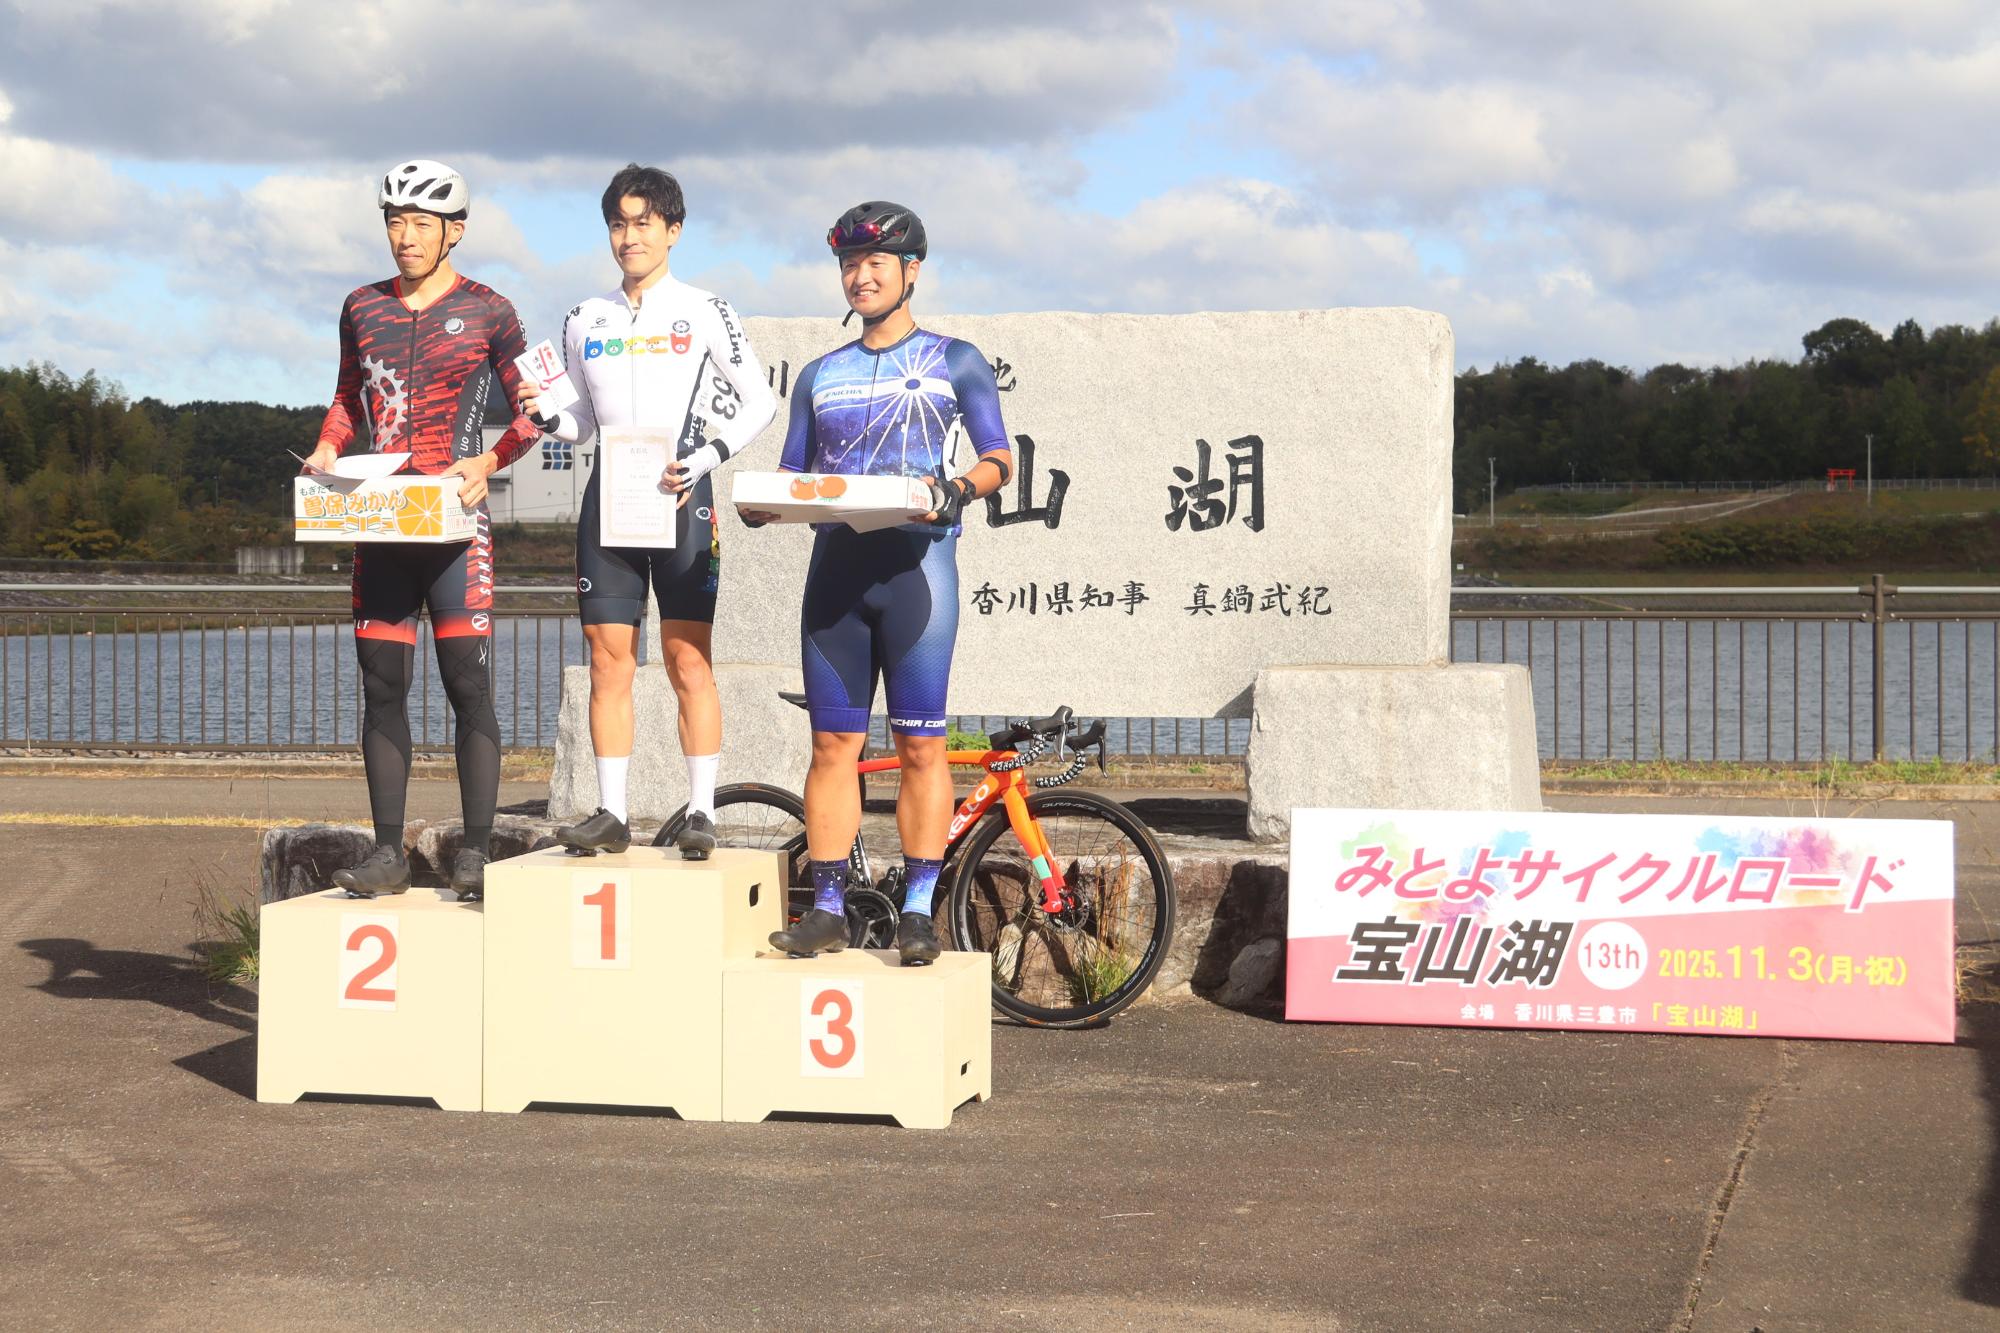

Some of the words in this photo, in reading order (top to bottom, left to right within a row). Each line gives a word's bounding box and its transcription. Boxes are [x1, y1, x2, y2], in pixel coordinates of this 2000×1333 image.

[707, 297, 743, 367] Racing
[465, 404, 477, 432] step
[712, 375, 737, 420] 53
[460, 437, 469, 452] on
[475, 509, 492, 596] SUNVOLT
[971, 580, 1150, 616] 香川県知事
[1183, 581, 1332, 617] 真鍋武紀
[1335, 846, 1906, 910] みとよサイクルロード
[583, 883, 616, 960] 1
[1336, 915, 1574, 986] 宝山湖
[1584, 942, 1640, 969] 13th
[344, 925, 397, 1003] 2
[809, 989, 857, 1069] 3
[1460, 1004, 1495, 1021] 会場
[1515, 1003, 1637, 1025] 香川県三豊市
[1652, 1002, 1758, 1030] 「宝山湖」
